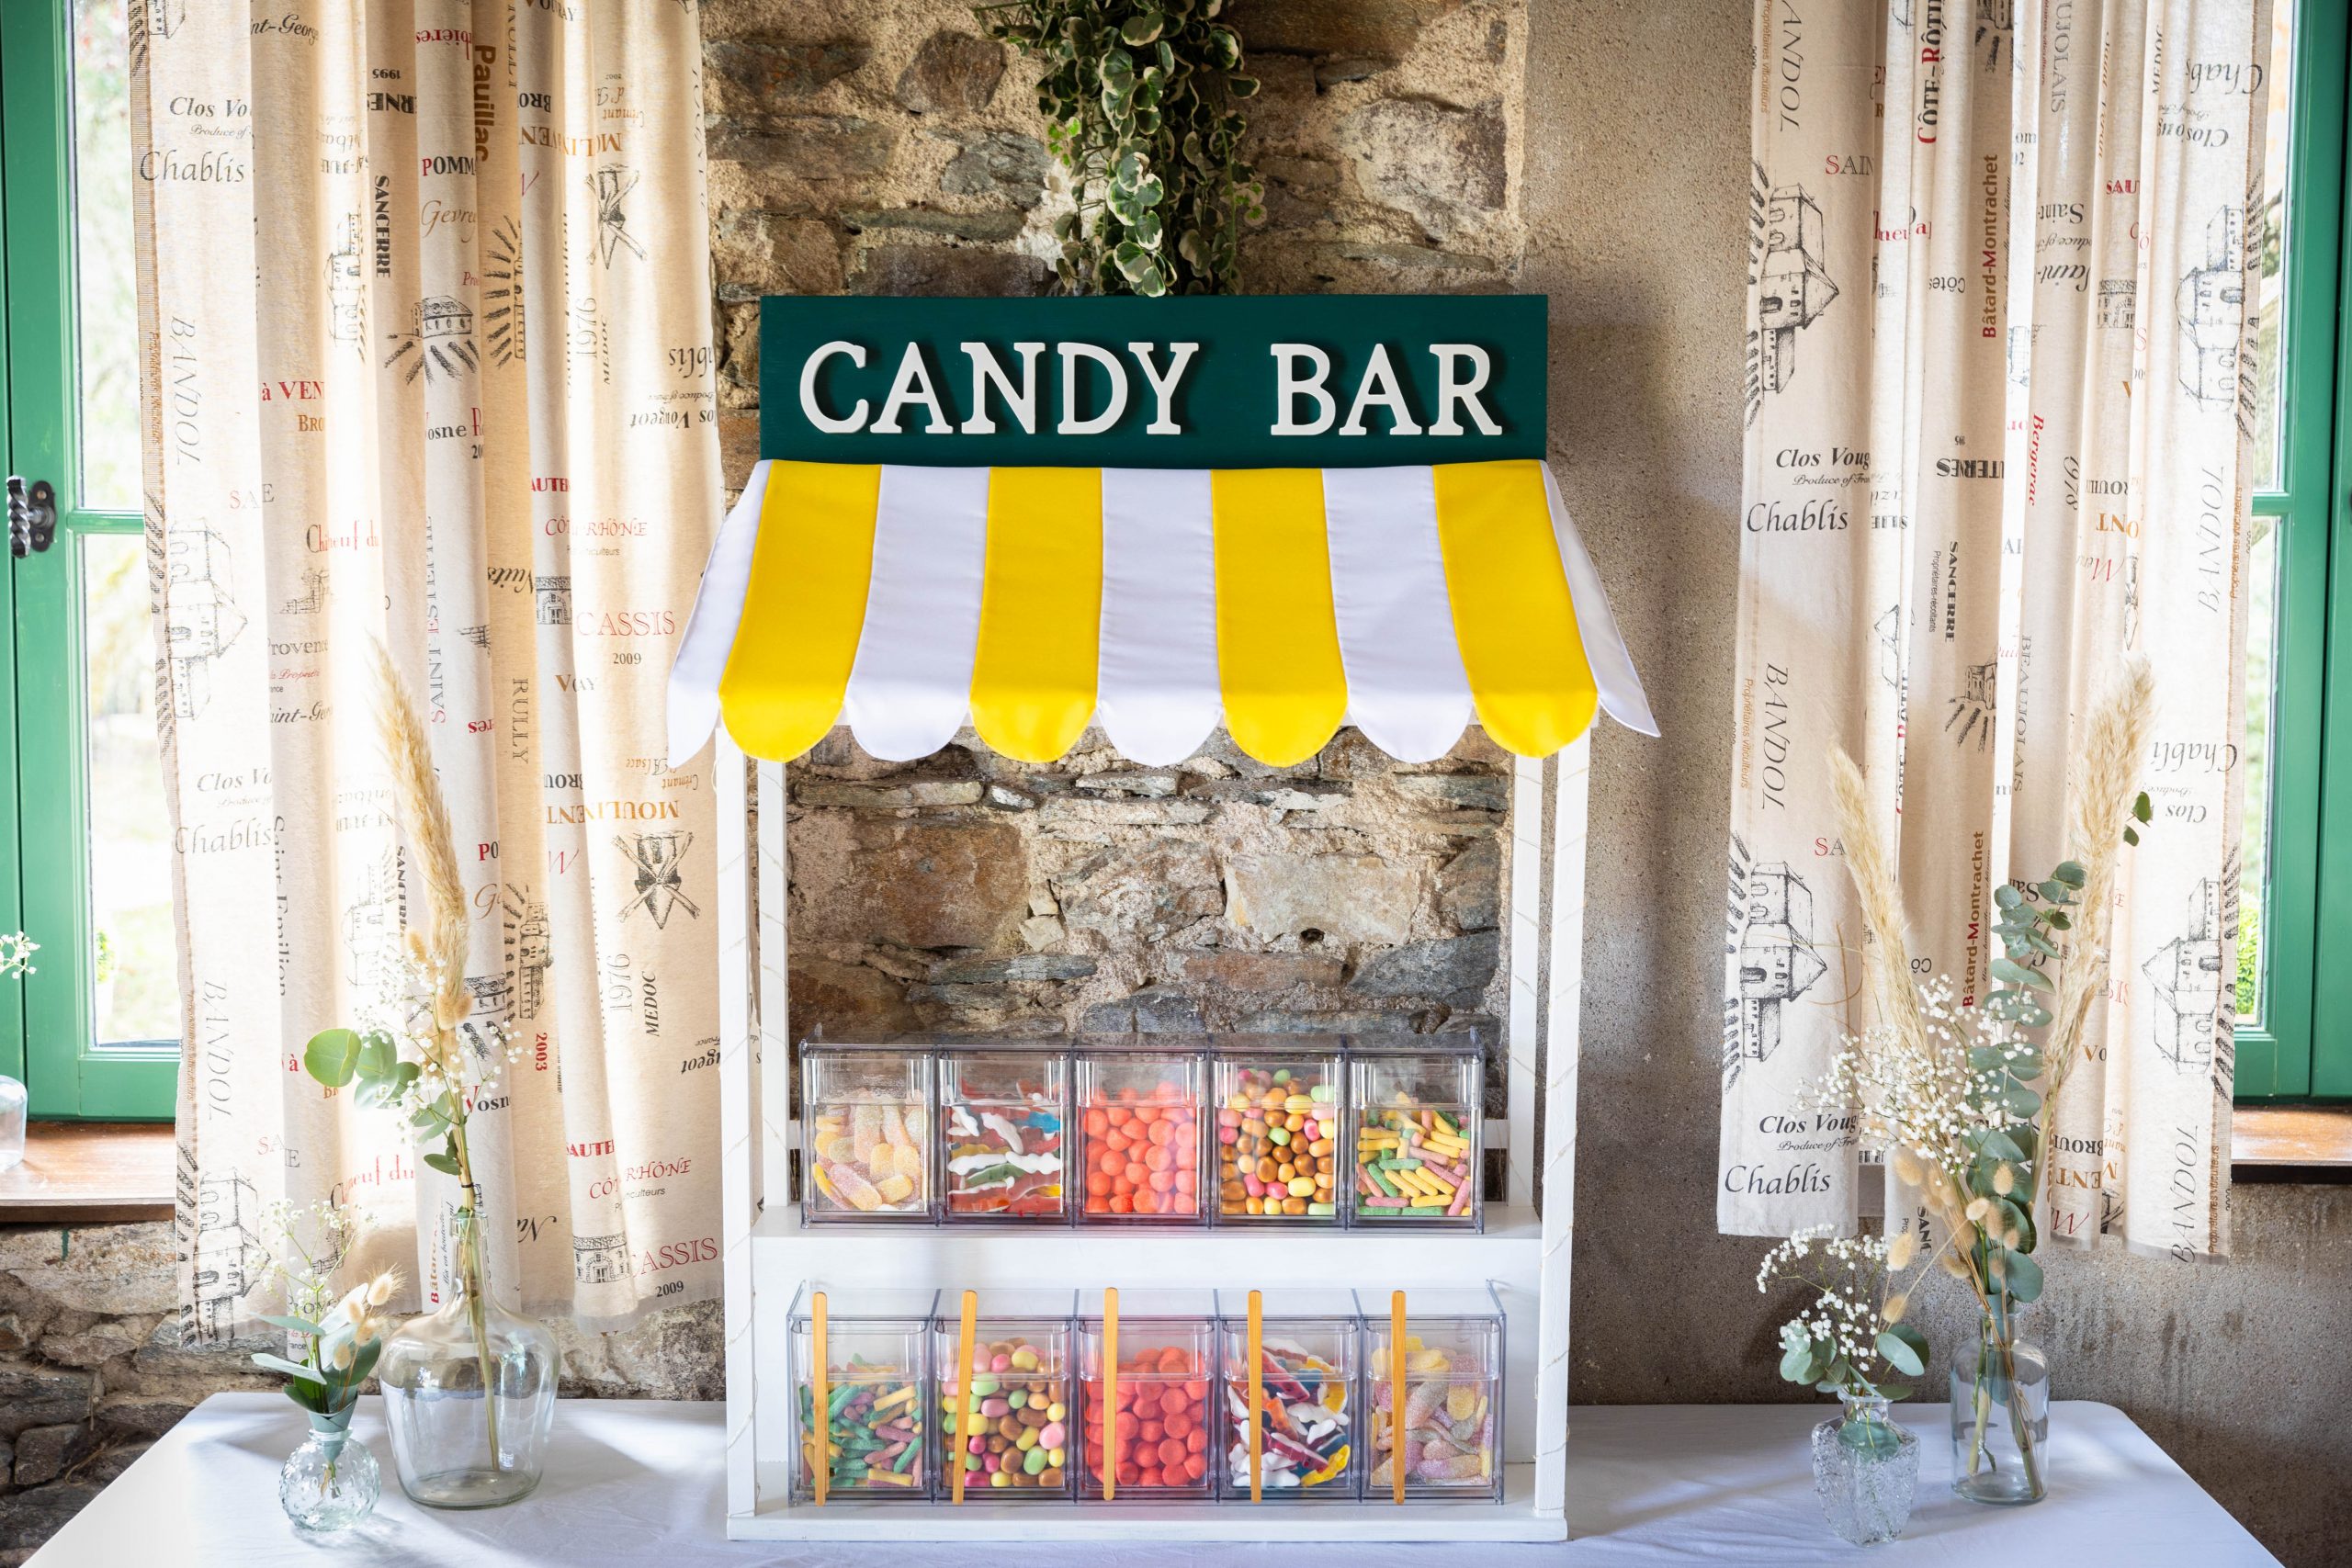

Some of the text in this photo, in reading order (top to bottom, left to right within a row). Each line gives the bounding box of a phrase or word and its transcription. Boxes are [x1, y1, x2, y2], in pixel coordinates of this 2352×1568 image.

[169, 96, 216, 118] Clos
[473, 45, 497, 163] Pauillac
[140, 149, 245, 183] Chablis
[2106, 179, 2141, 195] SAU
[374, 175, 391, 279] SANCERRE
[1982, 154, 1998, 338] Bâtard-Montrachet
[170, 316, 202, 466] BANDOL
[800, 341, 1503, 436] CANDY BAR
[425, 412, 468, 441] osne
[1775, 448, 1821, 468] Clos
[2027, 413, 2045, 507] Bergerac
[1746, 499, 1849, 532] Chablis
[2198, 465, 2225, 614] BANDOL
[1944, 540, 1959, 643] SANCERRE
[575, 610, 676, 637] CASSIS
[613, 652, 642, 666] 2009
[511, 677, 530, 765] RULLY
[1761, 662, 1791, 810] BANDOL
[197, 773, 243, 793] Clos
[2166, 804, 2207, 824] Clos
[174, 817, 273, 855] Chablis
[1962, 830, 1984, 1009] Bâtard-Montrachet
[605, 953, 633, 1014] 1976
[641, 970, 661, 1039] MEDOC
[202, 980, 234, 1122] BANDOL
[535, 1032, 548, 1072] 2003
[1758, 1114, 1807, 1135] Clos
[1777, 1140, 1825, 1152] Produce
[1724, 1163, 1832, 1195] Chablis
[2170, 1124, 2199, 1264] BANDOL
[630, 1236, 719, 1280] CASSIS
[655, 1280, 685, 1299] 2009
